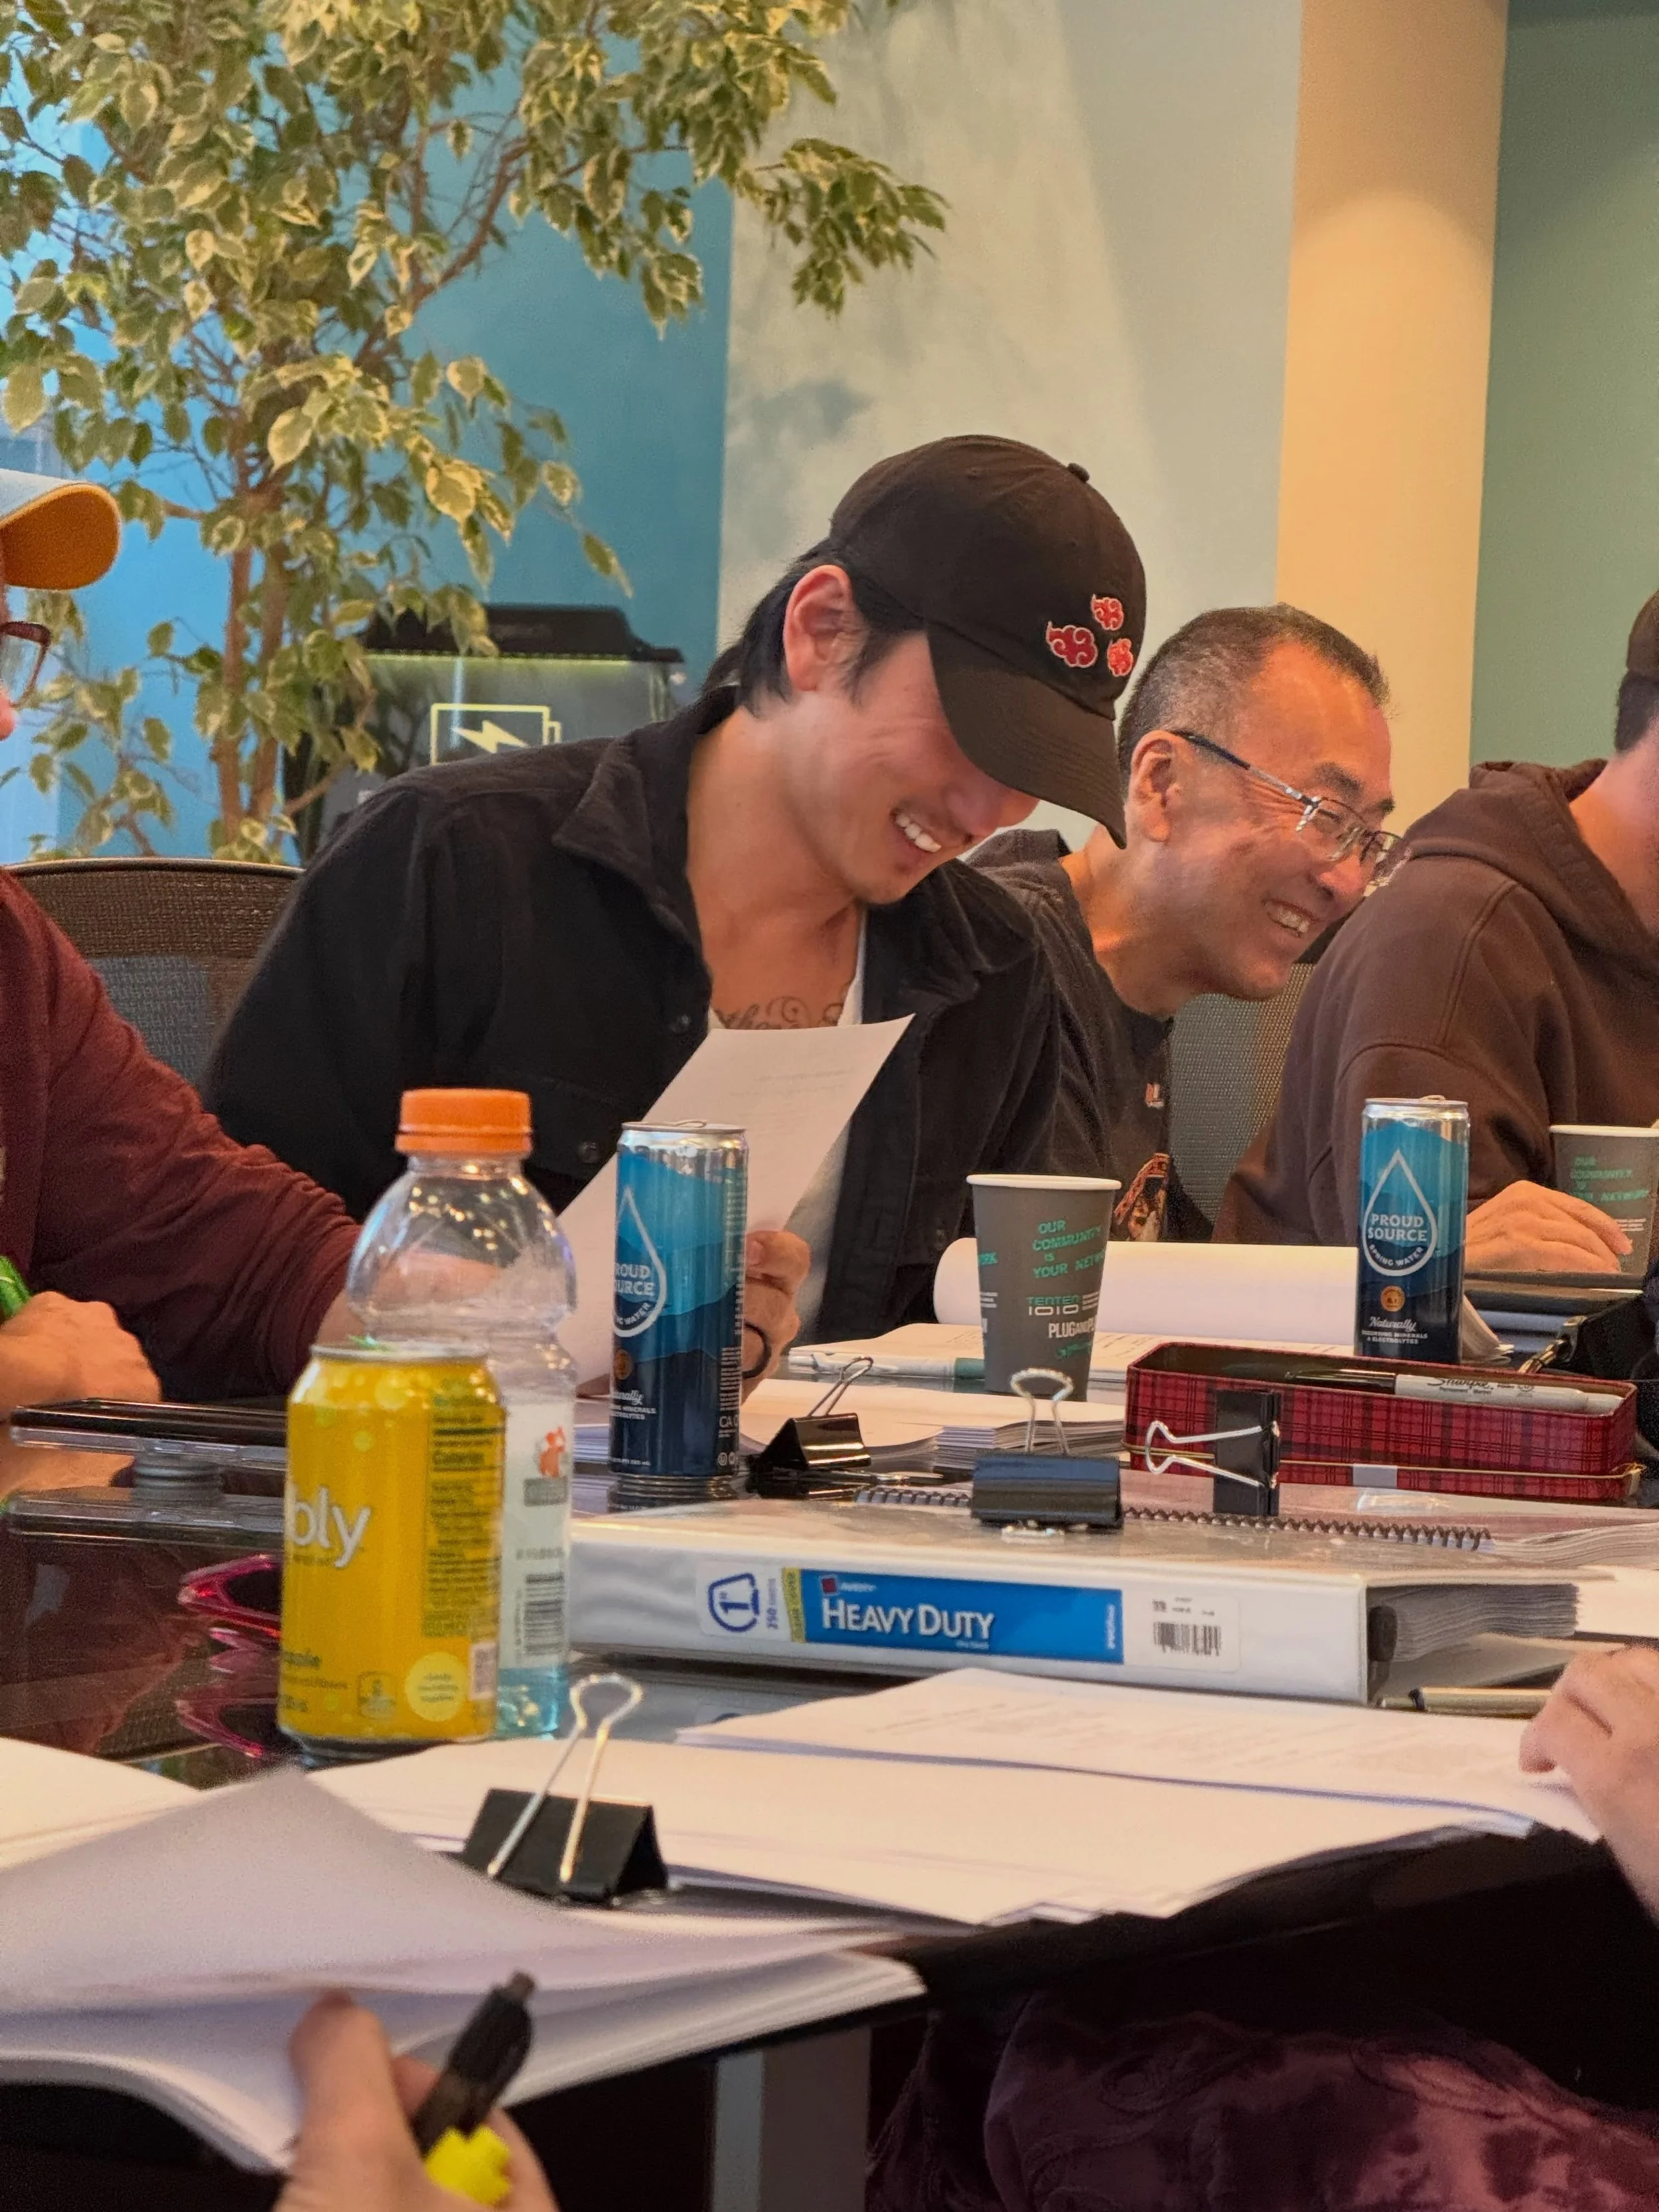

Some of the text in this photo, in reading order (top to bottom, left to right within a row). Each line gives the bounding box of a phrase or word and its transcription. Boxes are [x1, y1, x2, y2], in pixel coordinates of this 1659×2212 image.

[1037, 1219, 1066, 1235] OUR
[1371, 1213, 1425, 1228] PROUD
[1032, 1224, 1103, 1252] COMMUNITY
[1368, 1226, 1428, 1242] SOURCE
[1369, 1243, 1423, 1266] SPRING WATER
[1033, 1262, 1068, 1279] YOUR
[1369, 1315, 1417, 1333] Naturally
[822, 1597, 914, 1635] HEAVY
[917, 1603, 995, 1639] DUTY
